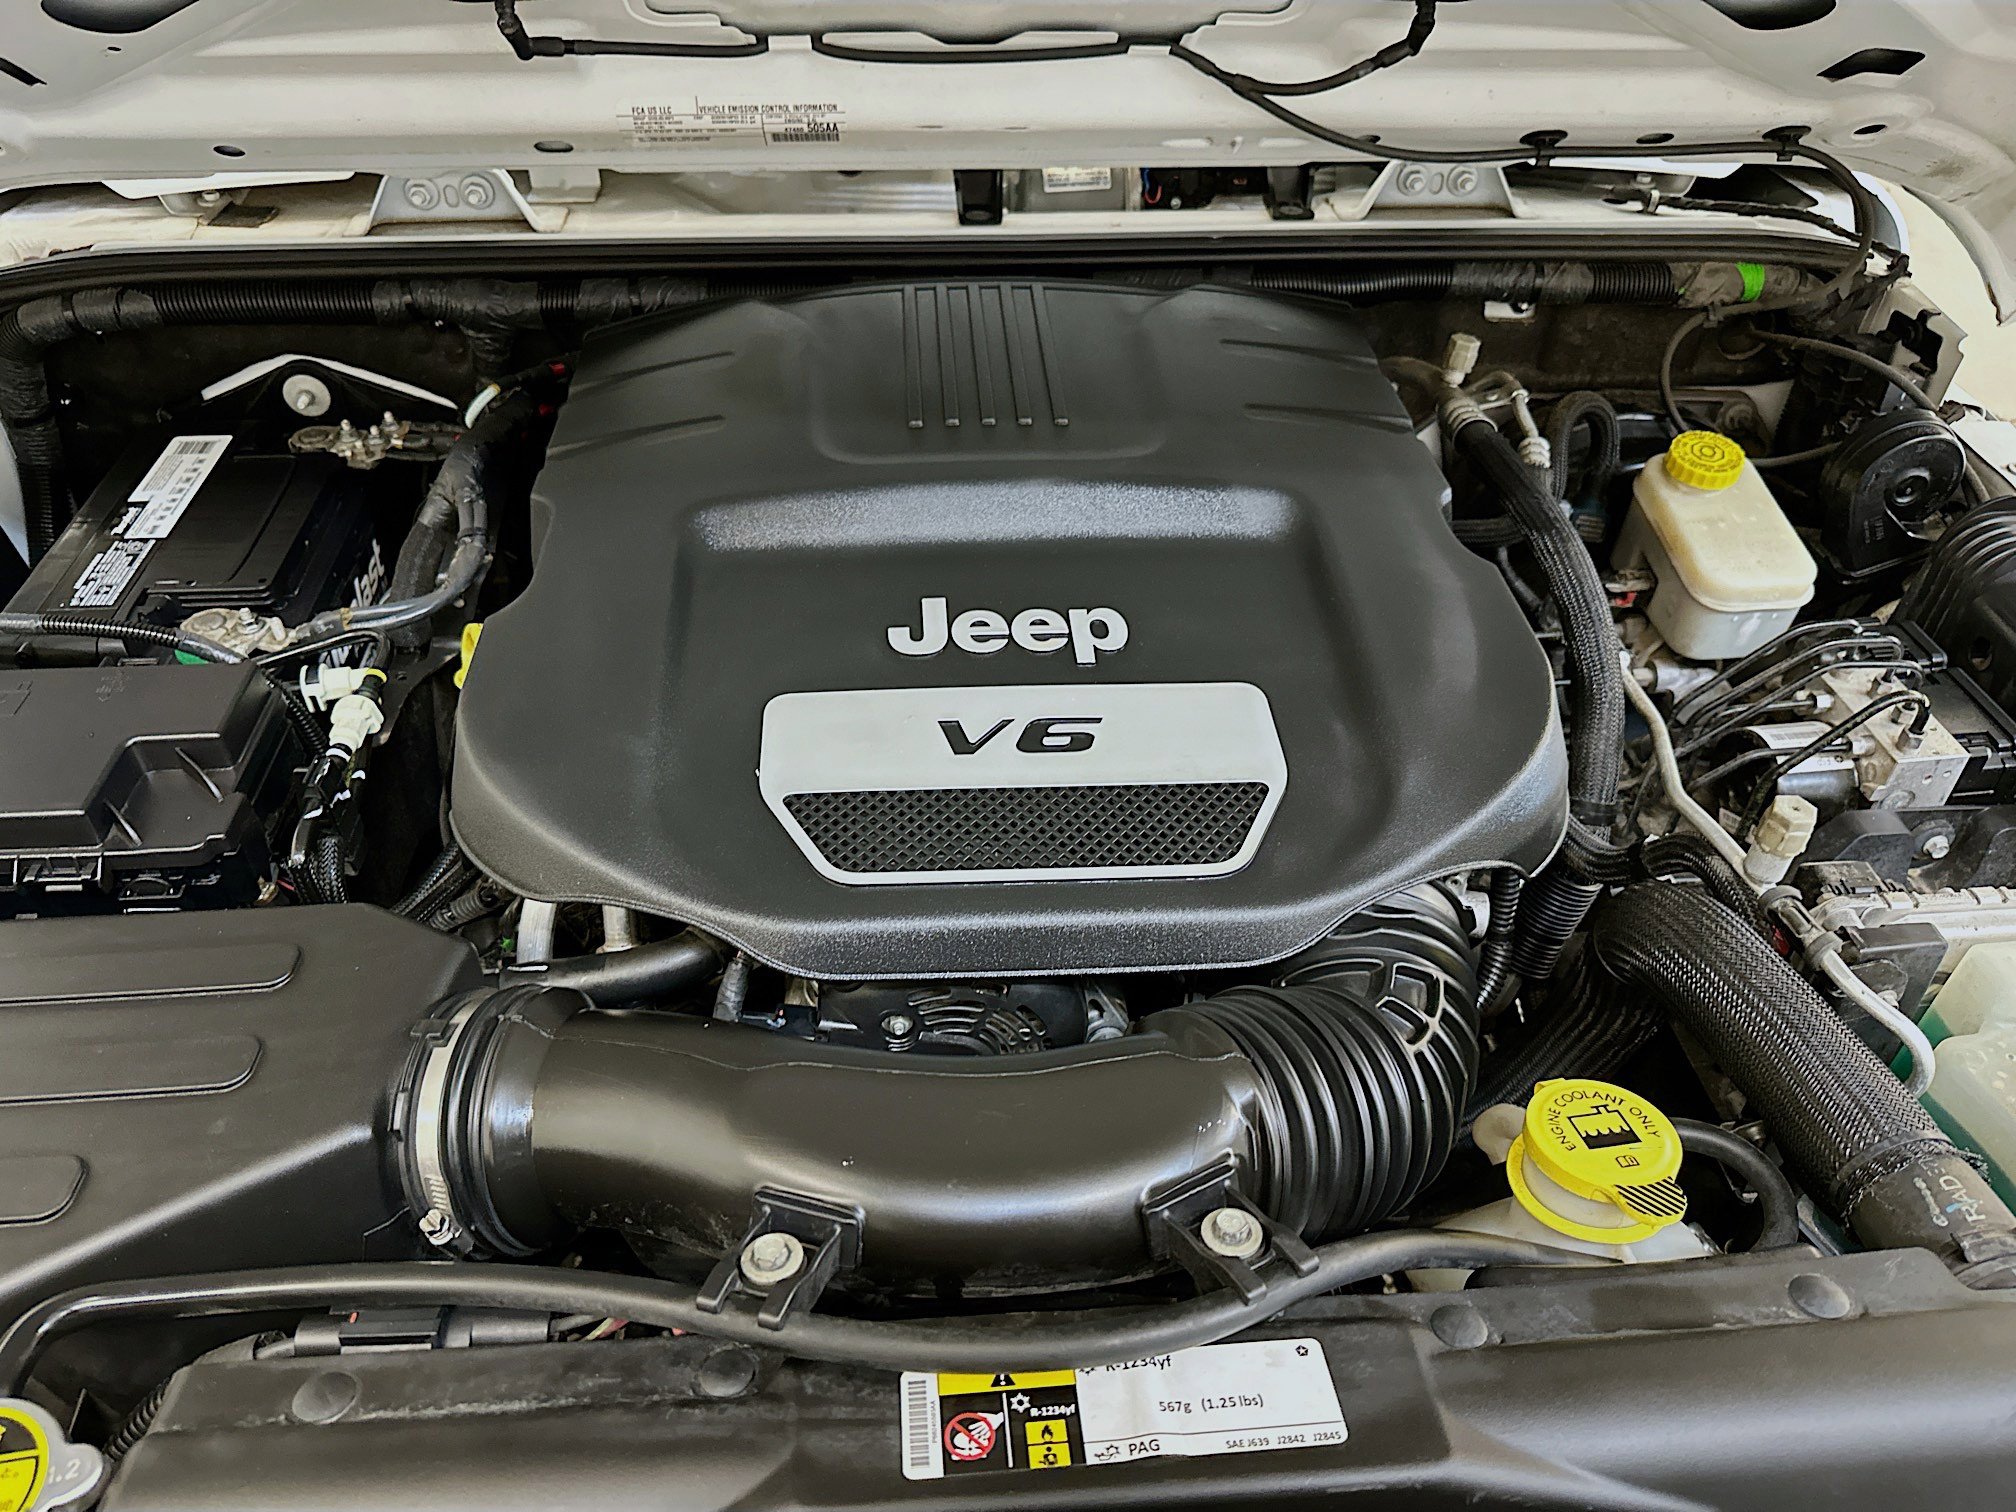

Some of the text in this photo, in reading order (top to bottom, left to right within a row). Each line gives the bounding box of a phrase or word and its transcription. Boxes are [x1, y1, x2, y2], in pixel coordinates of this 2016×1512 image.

[631, 106, 673, 115] FCA US LLC
[699, 103, 838, 114] VEHICLE EMISSION CONTROL INFORMATION
[807, 122, 839, 133] 505AA
[887, 597, 1129, 665] Jeep
[937, 717, 1103, 755] V6
[1547, 1090, 1661, 1152] ENGINE COOLANT ONLY
[1159, 1401, 1192, 1414] 567g
[1128, 1438, 1160, 1456] PAG
[1226, 1438, 1245, 1449] SAE
[1248, 1437, 1270, 1447] J639
